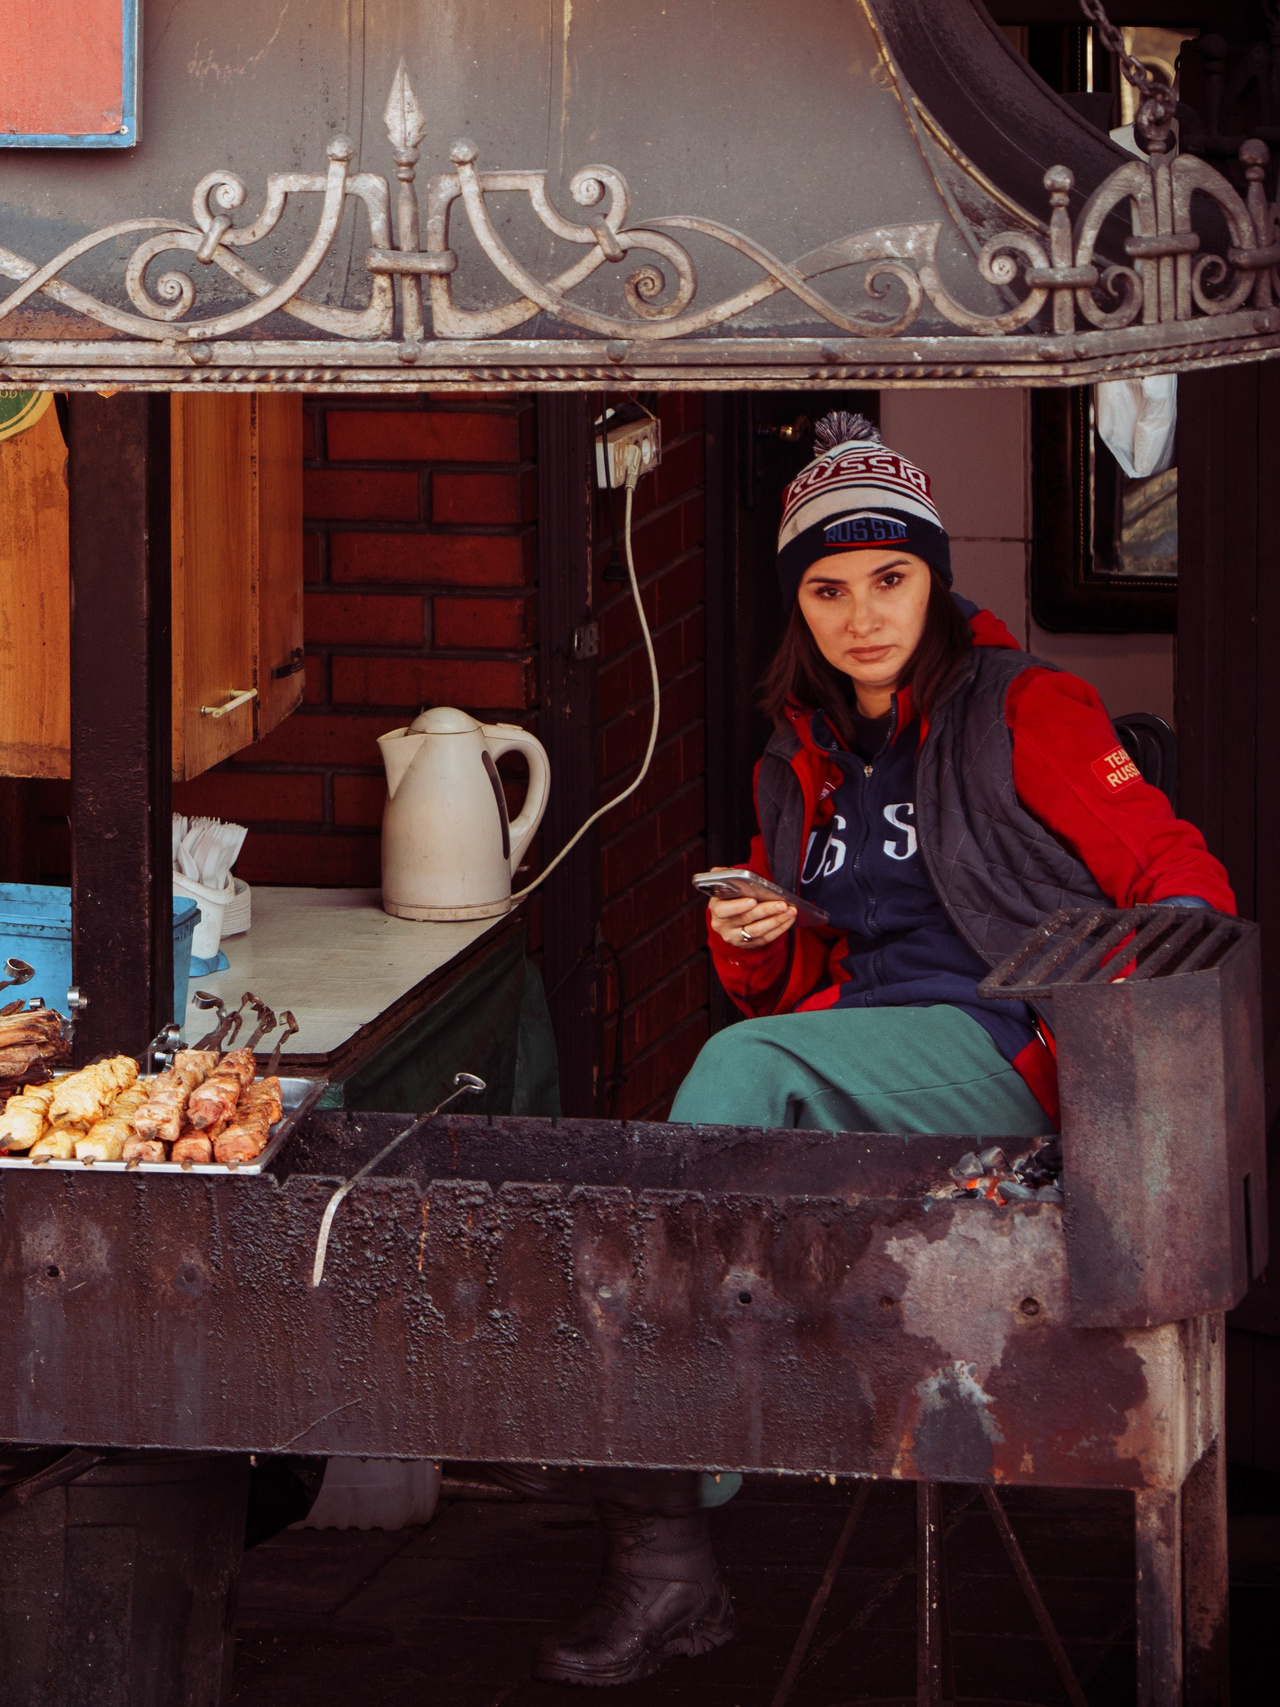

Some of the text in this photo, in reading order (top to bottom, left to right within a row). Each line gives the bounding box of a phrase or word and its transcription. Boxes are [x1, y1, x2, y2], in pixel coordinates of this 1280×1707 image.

[785, 456, 928, 508] RUSSIA
[825, 518, 908, 543] RUSSIA
[1104, 748, 1131, 769] TEA
